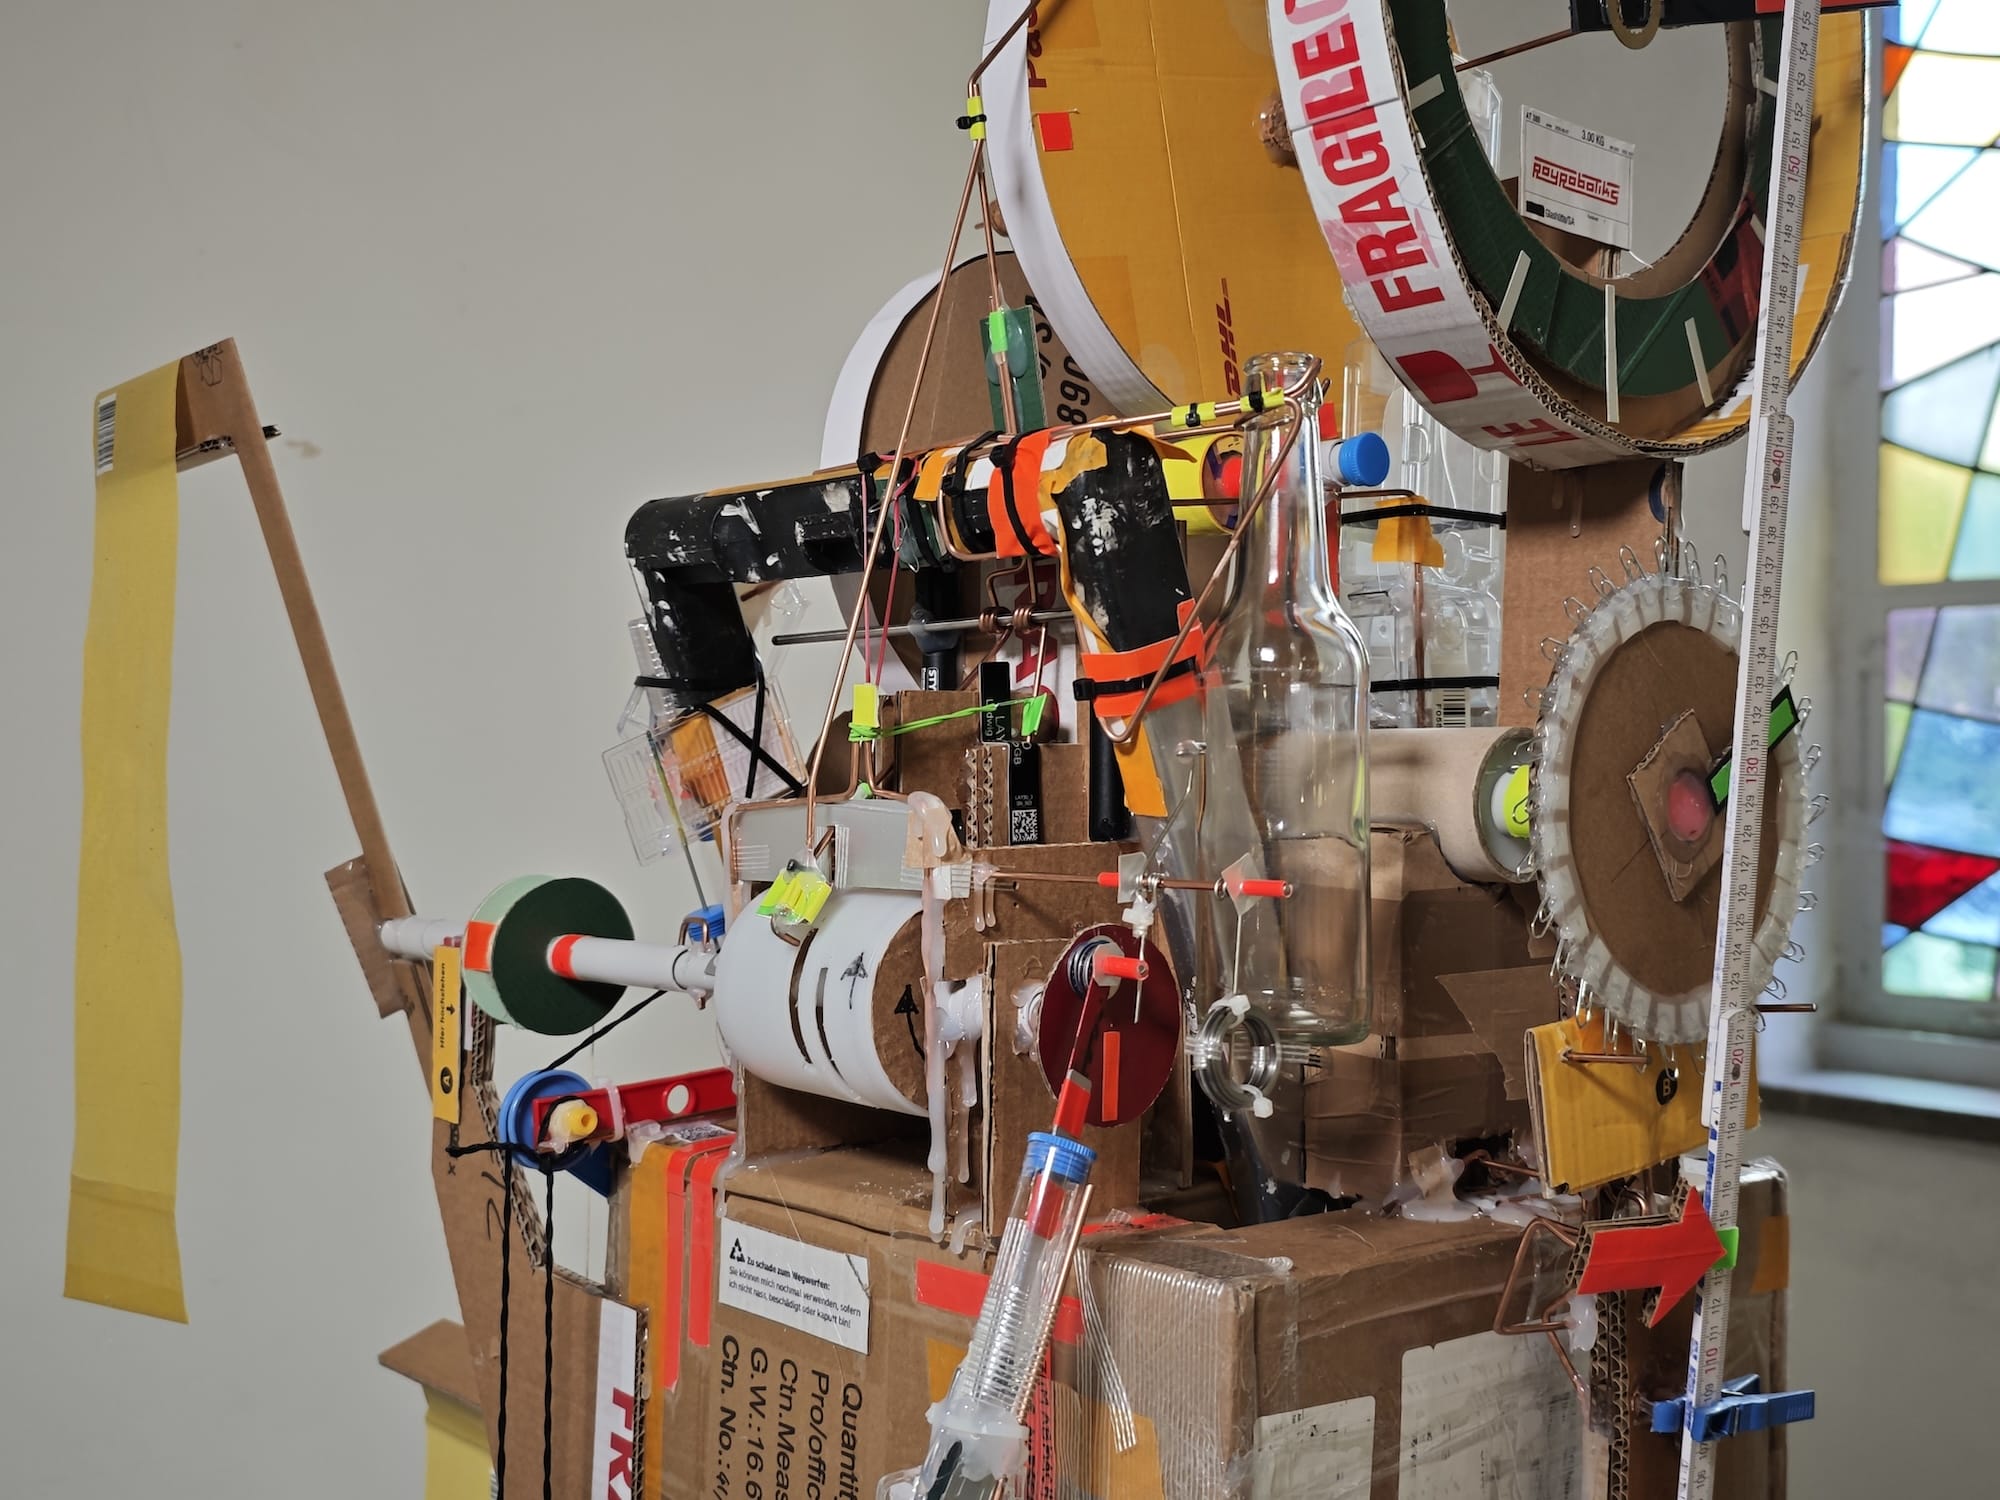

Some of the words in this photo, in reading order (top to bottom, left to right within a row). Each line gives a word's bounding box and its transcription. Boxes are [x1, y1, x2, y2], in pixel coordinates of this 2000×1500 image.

[1801, 11, 1811, 31] 155
[1799, 42, 1808, 61] 154
[1796, 72, 1806, 91] 153
[1794, 102, 1804, 122] 152
[1582, 130, 1594, 143] 3.00
[1596, 135, 1605, 147] KG
[1791, 132, 1801, 150] 151
[1787, 155, 1800, 182] 150
[1786, 194, 1796, 213] 149
[1784, 224, 1793, 243] 148
[1781, 255, 1791, 274] 147
[1779, 285, 1788, 304] 146
[1776, 315, 1786, 334] 145
[1216, 297, 1241, 397] DHL
[1773, 346, 1782, 364] 144
[1770, 376, 1781, 394] 143
[1770, 496, 1780, 515] 139
[1768, 526, 1777, 544] 138
[1765, 557, 1774, 574] 137
[1762, 586, 1772, 605] 136
[1760, 616, 1769, 634] 135
[1757, 646, 1767, 664] 134
[1755, 676, 1765, 694] 133
[985, 698, 994, 737] Ldwig
[1752, 706, 1762, 724] 132
[1750, 734, 1760, 751] 131
[1746, 757, 1759, 784] 130
[1745, 795, 1755, 813] 129
[1743, 825, 1752, 843] 128
[1740, 855, 1750, 873] 127
[1738, 884, 1747, 902] 126
[1736, 913, 1745, 932] 125
[1733, 943, 1742, 961] 124
[1731, 972, 1741, 991] 123
[1662, 1079, 1671, 1097] B
[1730, 1093, 1739, 1110] 119
[1727, 1122, 1737, 1139] 118
[1724, 1153, 1734, 1169] 117
[1722, 1180, 1732, 1198] 116
[1719, 1210, 1729, 1227] 115
[747, 1256, 755, 1266] Zu
[755, 1260, 777, 1273] schade
[777, 1267, 791, 1278] zum
[760, 1277, 775, 1288] mich
[840, 1302, 861, 1317] sofern
[1711, 1298, 1721, 1315] 112
[720, 1335, 740, 1395] Ctn.
[1705, 1347, 1718, 1374] 110
[1703, 1383, 1714, 1402] 109
